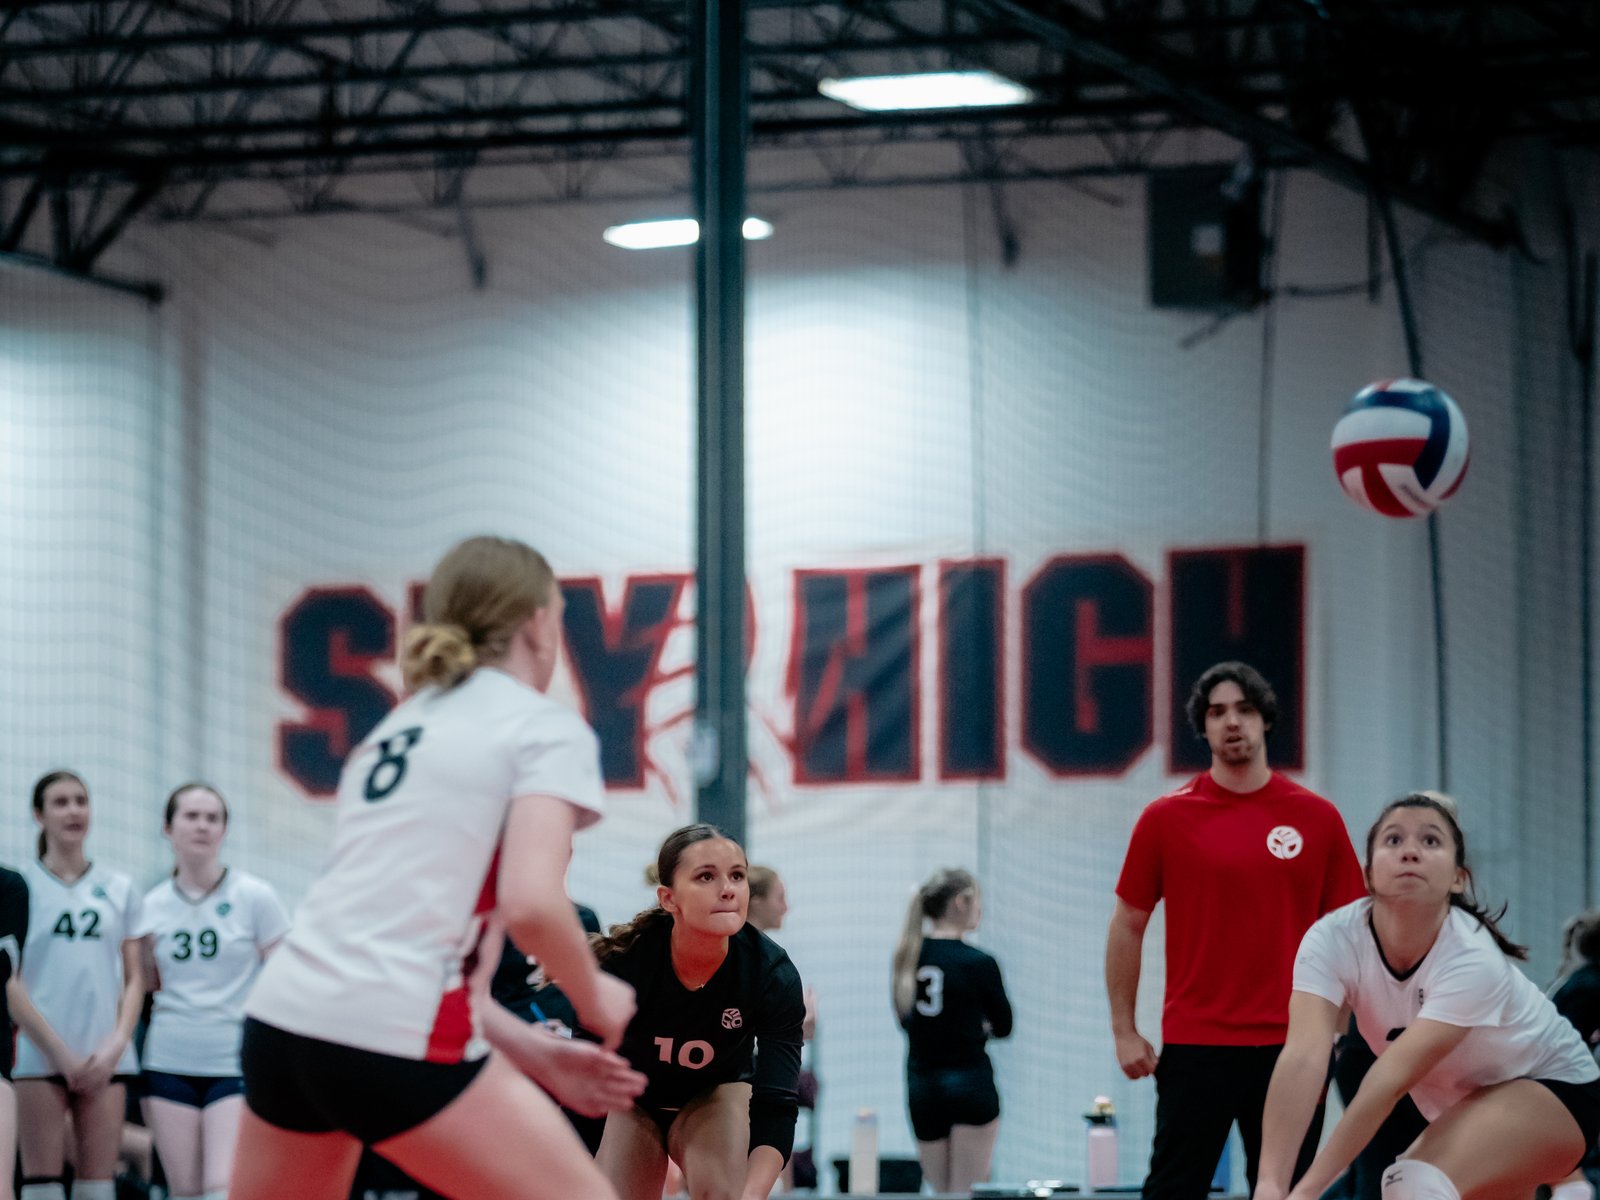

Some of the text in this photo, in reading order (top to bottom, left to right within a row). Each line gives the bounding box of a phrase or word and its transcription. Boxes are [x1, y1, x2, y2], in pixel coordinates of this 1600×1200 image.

[273, 544, 1306, 801] SY HIGH
[363, 726, 424, 803] 8
[53, 910, 102, 939] 42
[172, 929, 218, 960] 39
[916, 964, 945, 1017] 3
[654, 1036, 715, 1070] 10
